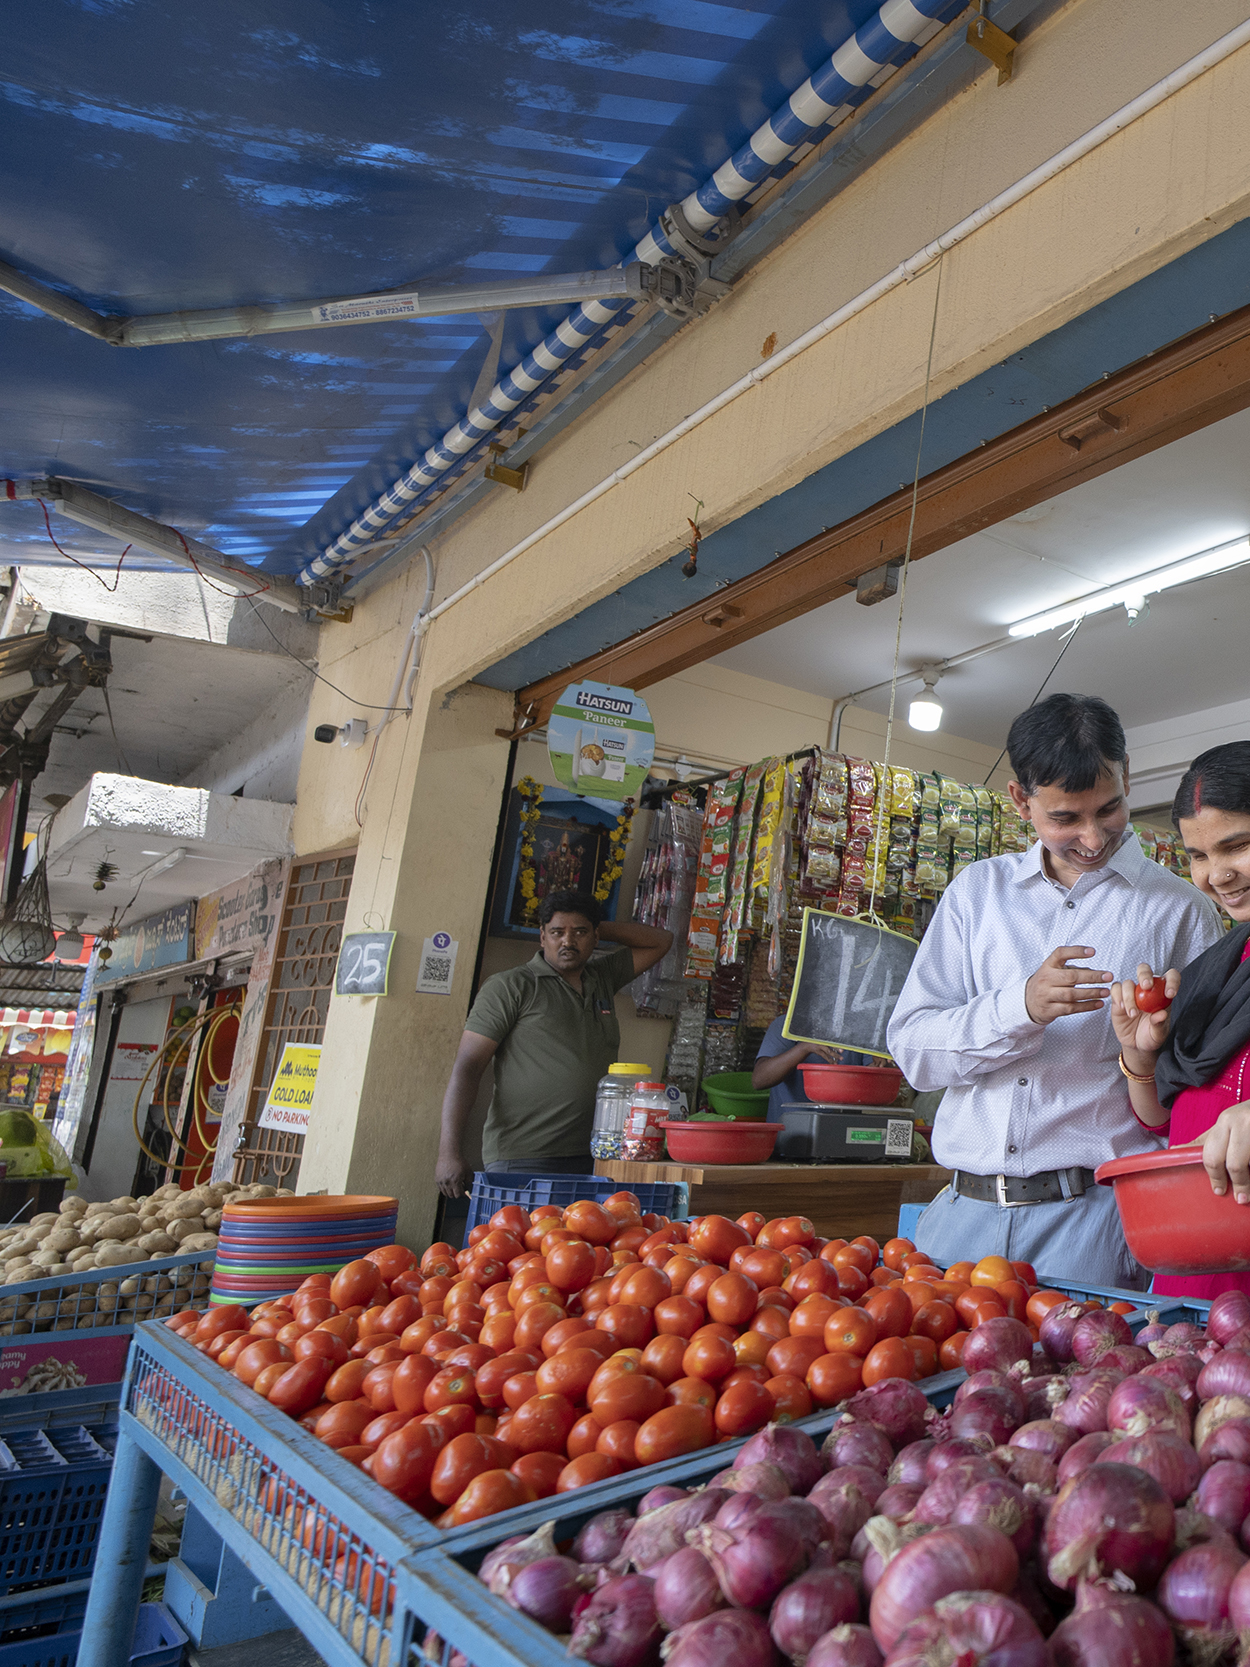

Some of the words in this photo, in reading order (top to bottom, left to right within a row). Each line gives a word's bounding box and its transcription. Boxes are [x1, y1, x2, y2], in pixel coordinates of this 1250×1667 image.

[579, 691, 630, 714] HATSUN
[583, 710, 627, 727] Paneer
[603, 739, 624, 749] HATSUN
[248, 910, 276, 948] Shop
[811, 918, 844, 939] KG
[344, 942, 385, 984] 25
[832, 934, 900, 1047] 14
[294, 1063, 317, 1078] Muthoo
[274, 1087, 294, 1103] GOLD
[272, 1109, 283, 1122] NO
